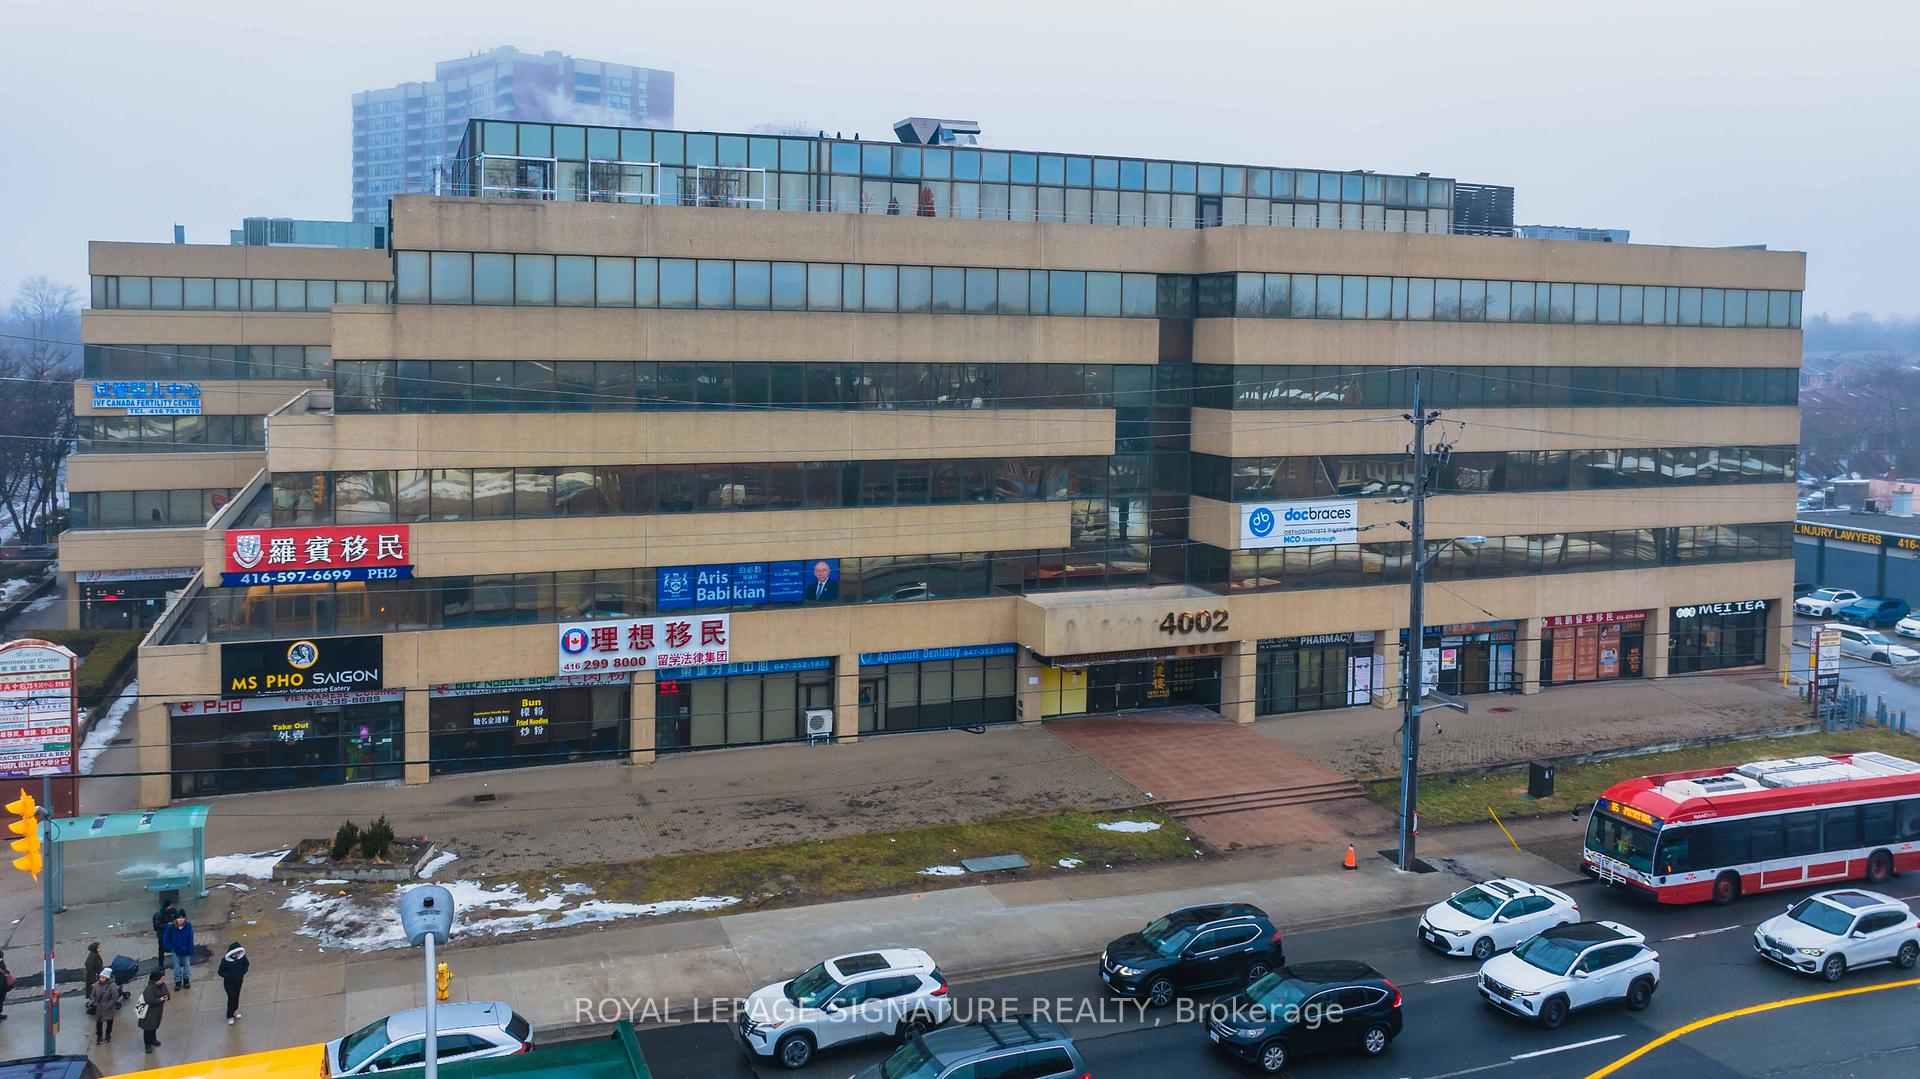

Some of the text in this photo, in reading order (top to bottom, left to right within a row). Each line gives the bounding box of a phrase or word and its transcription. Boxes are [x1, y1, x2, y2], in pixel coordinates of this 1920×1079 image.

[93, 399, 200, 407] IVF CANADA FERTILITY CENTRE
[1284, 507, 1351, 521] docbraces
[1801, 524, 1833, 537] INJURY
[1834, 530, 1882, 545] LAWYERS
[268, 533, 403, 564] 羅賓移民
[240, 568, 398, 584] 416-597-6699 PH2
[698, 571, 728, 585] Aris
[1698, 603, 1732, 615] MEI
[1735, 600, 1766, 611] TEA
[1159, 608, 1229, 635] 4002
[591, 620, 727, 653] 理想移民
[1300, 633, 1353, 645] PHARMACY
[657, 651, 728, 667] 留学法律集团
[878, 650, 919, 664] Agincourt
[923, 647, 961, 658] Dentistry
[564, 656, 647, 671] 416 299 8000
[231, 668, 378, 691] MS PHO SAIGON
[485, 678, 524, 688] NOODLE
[329, 685, 351, 693] Eatery
[521, 699, 542, 707] Bun
[294, 722, 310, 730] Out
[516, 718, 549, 727] Fried Noodles
